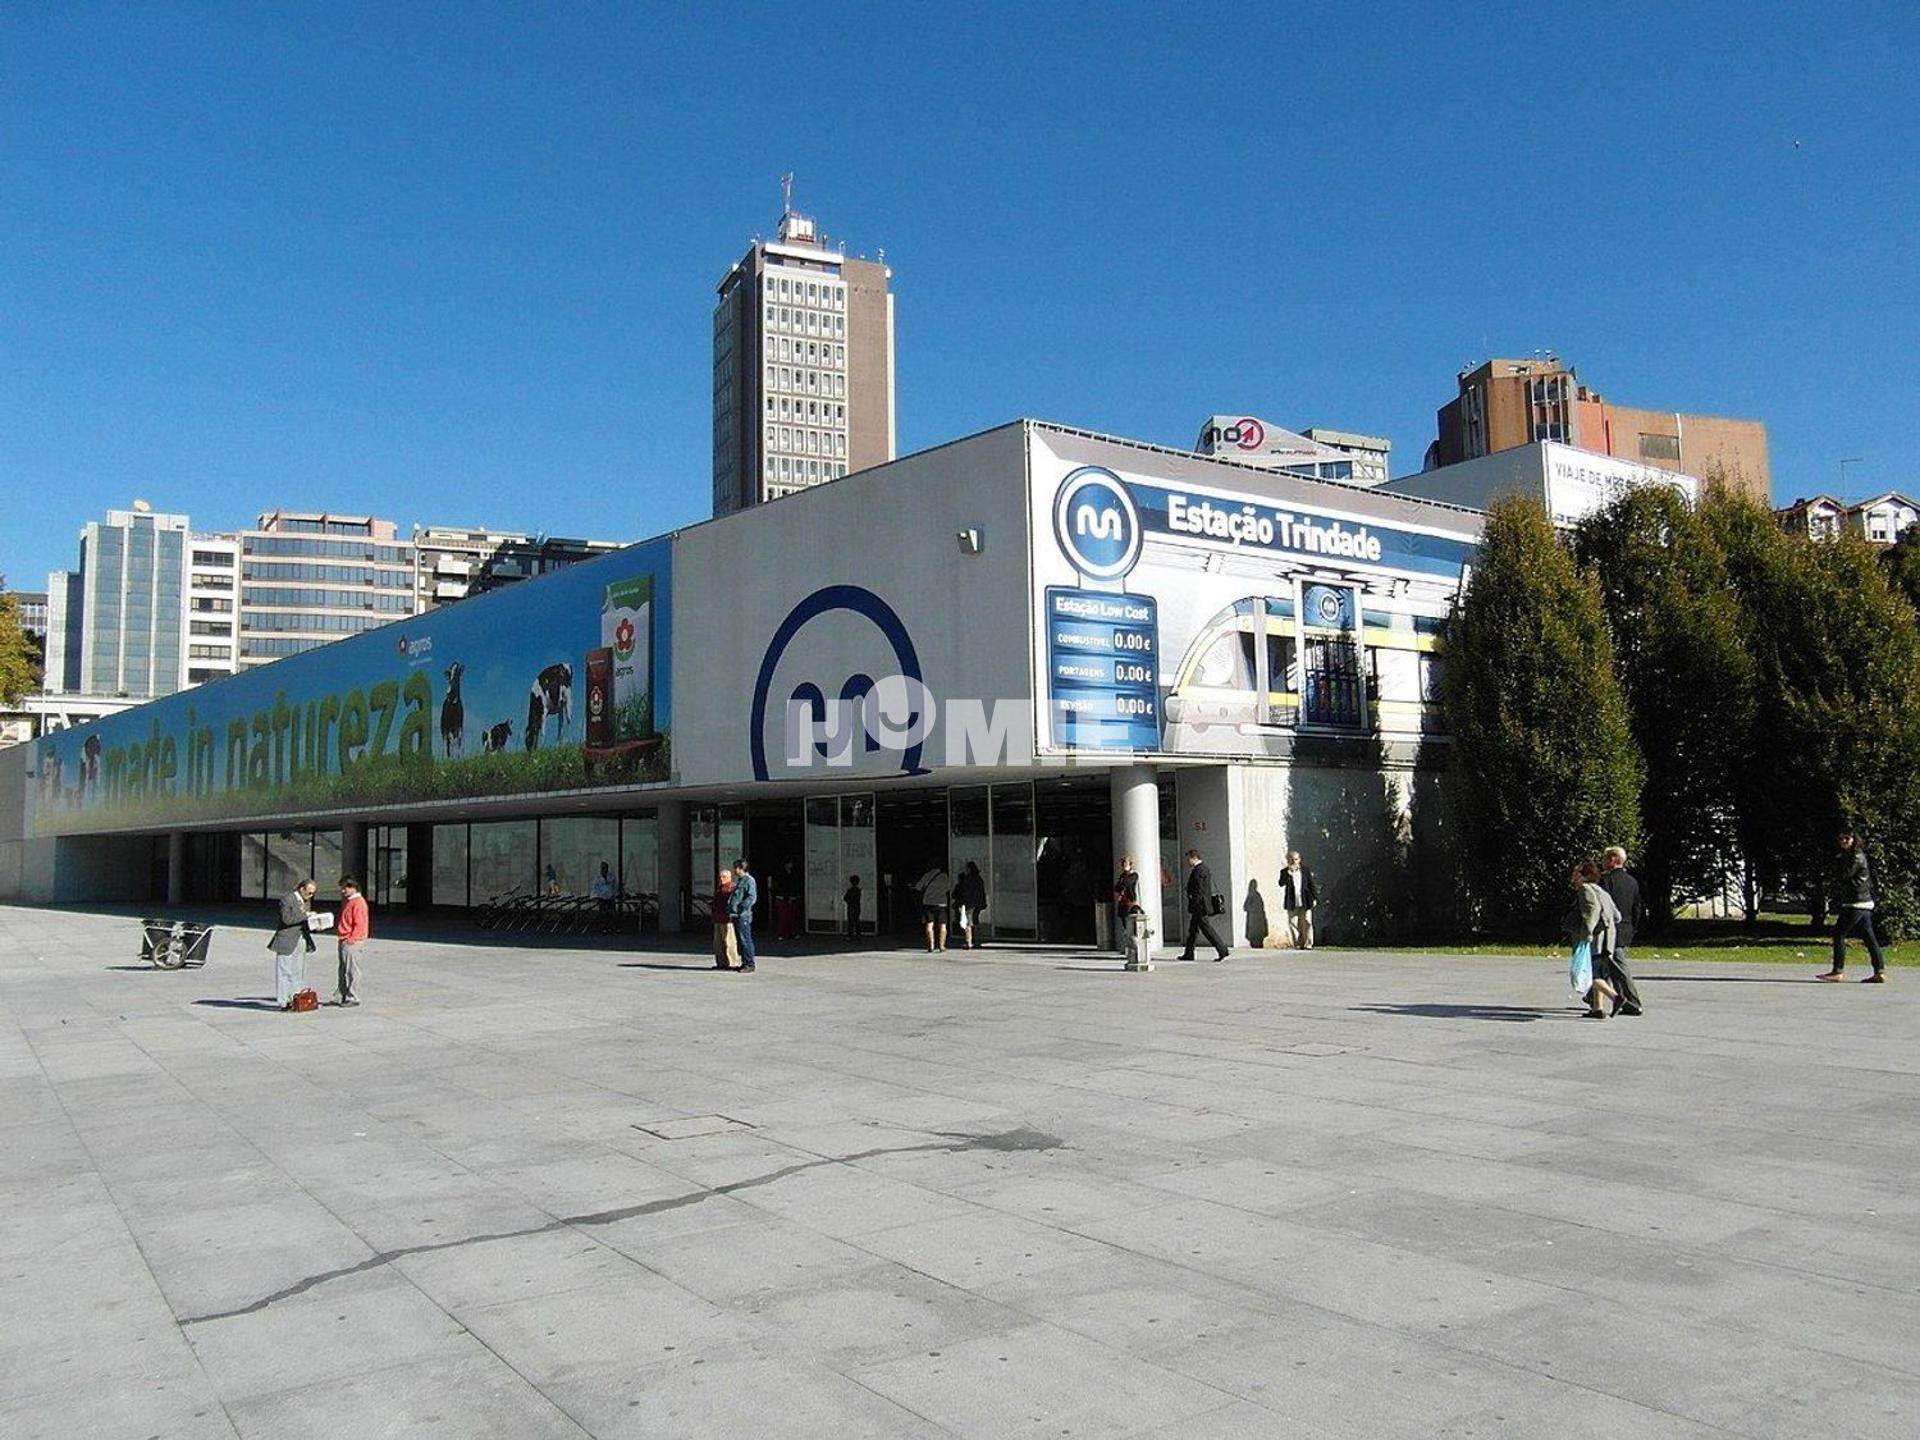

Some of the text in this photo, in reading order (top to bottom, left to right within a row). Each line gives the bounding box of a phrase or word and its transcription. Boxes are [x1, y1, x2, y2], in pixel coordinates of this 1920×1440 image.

[1555, 462, 1586, 482] VIAJE
[1588, 470, 1601, 486] DE
[1167, 494, 1382, 561] Estação Trindade
[1055, 597, 1149, 621] Estação Low Cost
[106, 668, 433, 803] made in natureza
